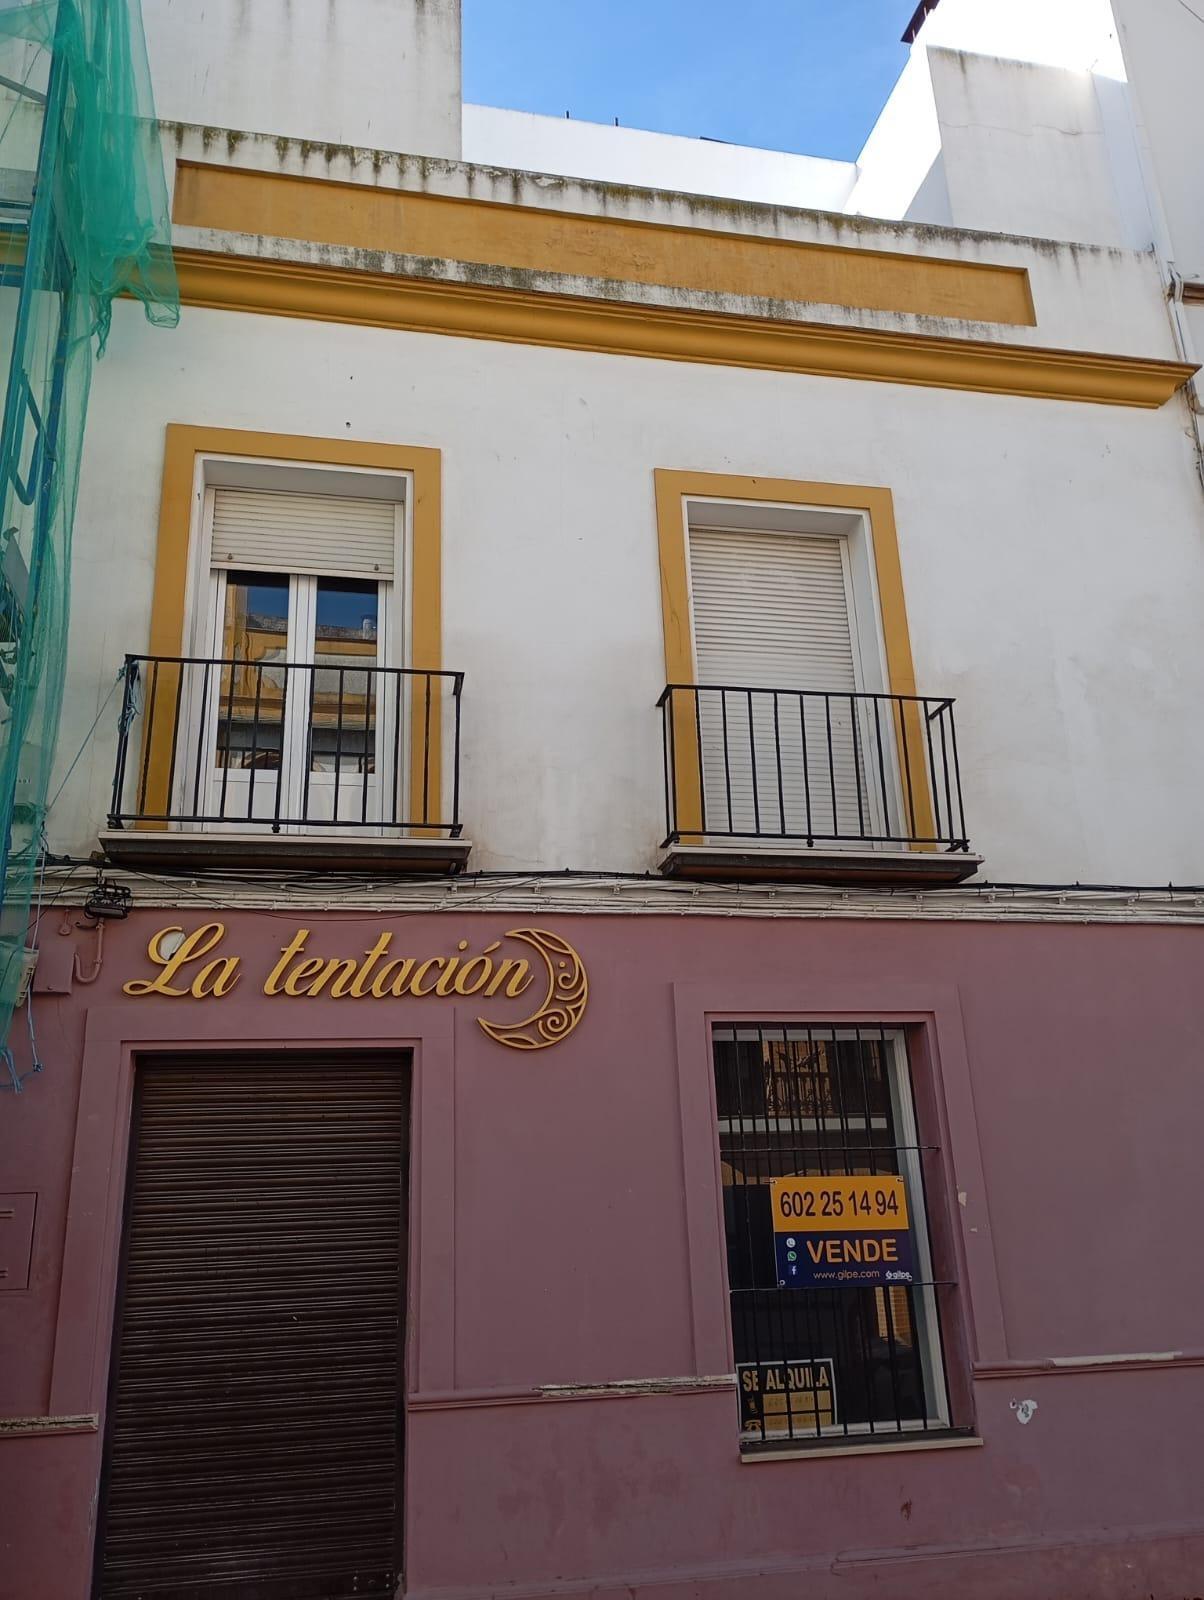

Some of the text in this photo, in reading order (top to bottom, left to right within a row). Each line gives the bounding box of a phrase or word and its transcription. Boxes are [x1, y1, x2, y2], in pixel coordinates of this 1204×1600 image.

[122, 922, 535, 999] La tentación
[780, 1190, 899, 1217] 602 25 14 94
[806, 1239, 898, 1263] VENDE
[813, 1270, 880, 1280] www.gilpe.com
[742, 1370, 759, 1392] SE
